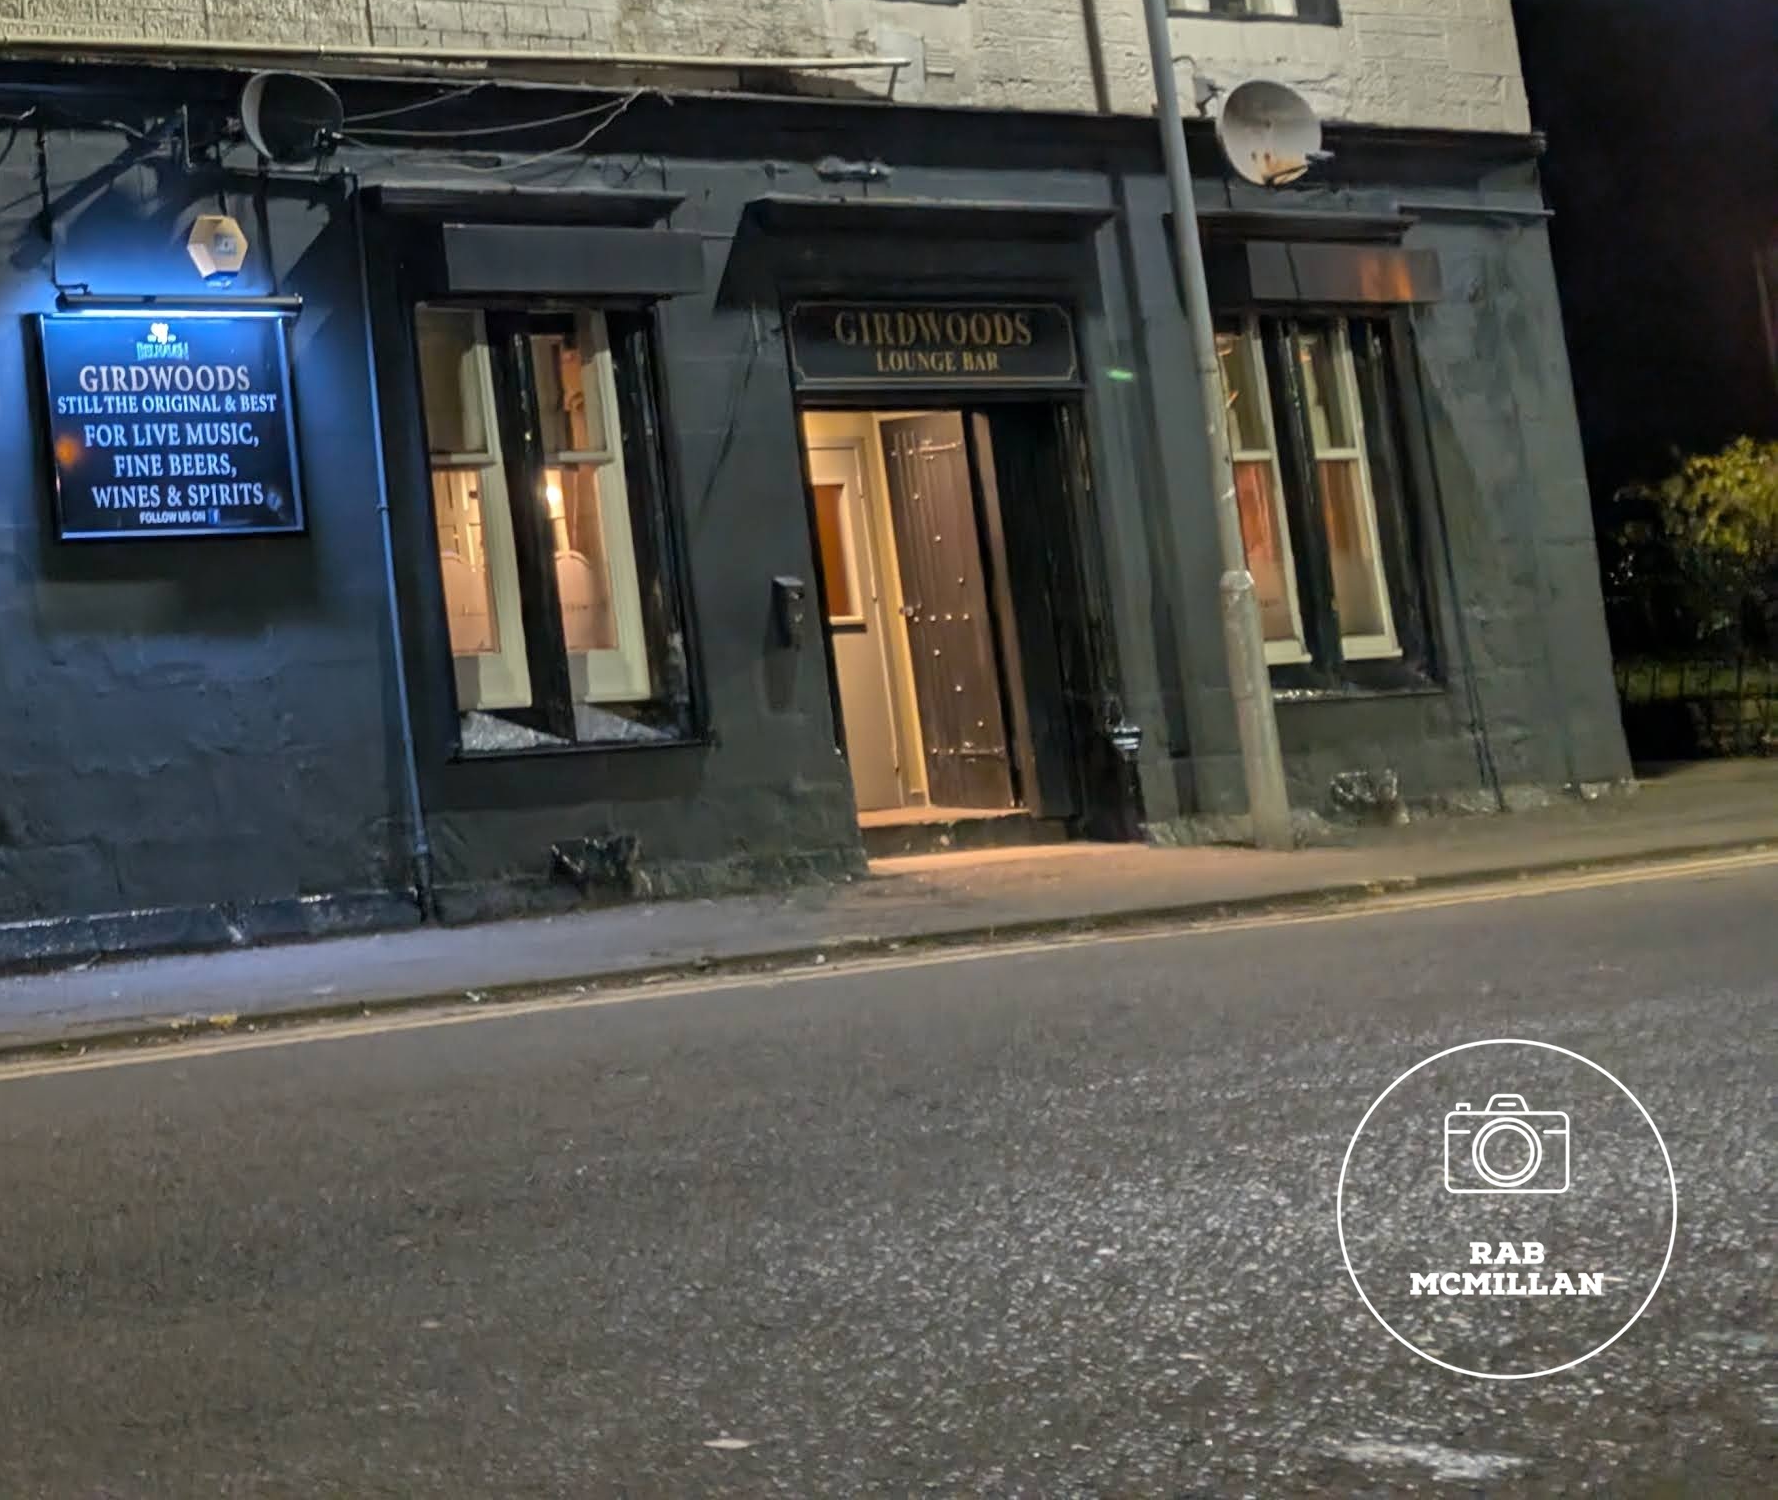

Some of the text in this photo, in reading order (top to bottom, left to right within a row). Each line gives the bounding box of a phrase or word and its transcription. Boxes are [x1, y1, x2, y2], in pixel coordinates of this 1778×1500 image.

[834, 311, 1032, 346] GIRDWOODS
[876, 351, 999, 373] LOUNGE BAR
[79, 365, 251, 392] GIRDWOODS
[57, 394, 277, 414] STILL THE ORIGINAL & BEST
[84, 422, 260, 447] FOR LIVE MUSIC,
[114, 453, 238, 478] FINE BEERS,
[92, 482, 264, 509] WINES & SPIRITS
[139, 511, 177, 525] FOLLOW
[177, 510, 191, 523] US
[191, 510, 206, 522] ON
